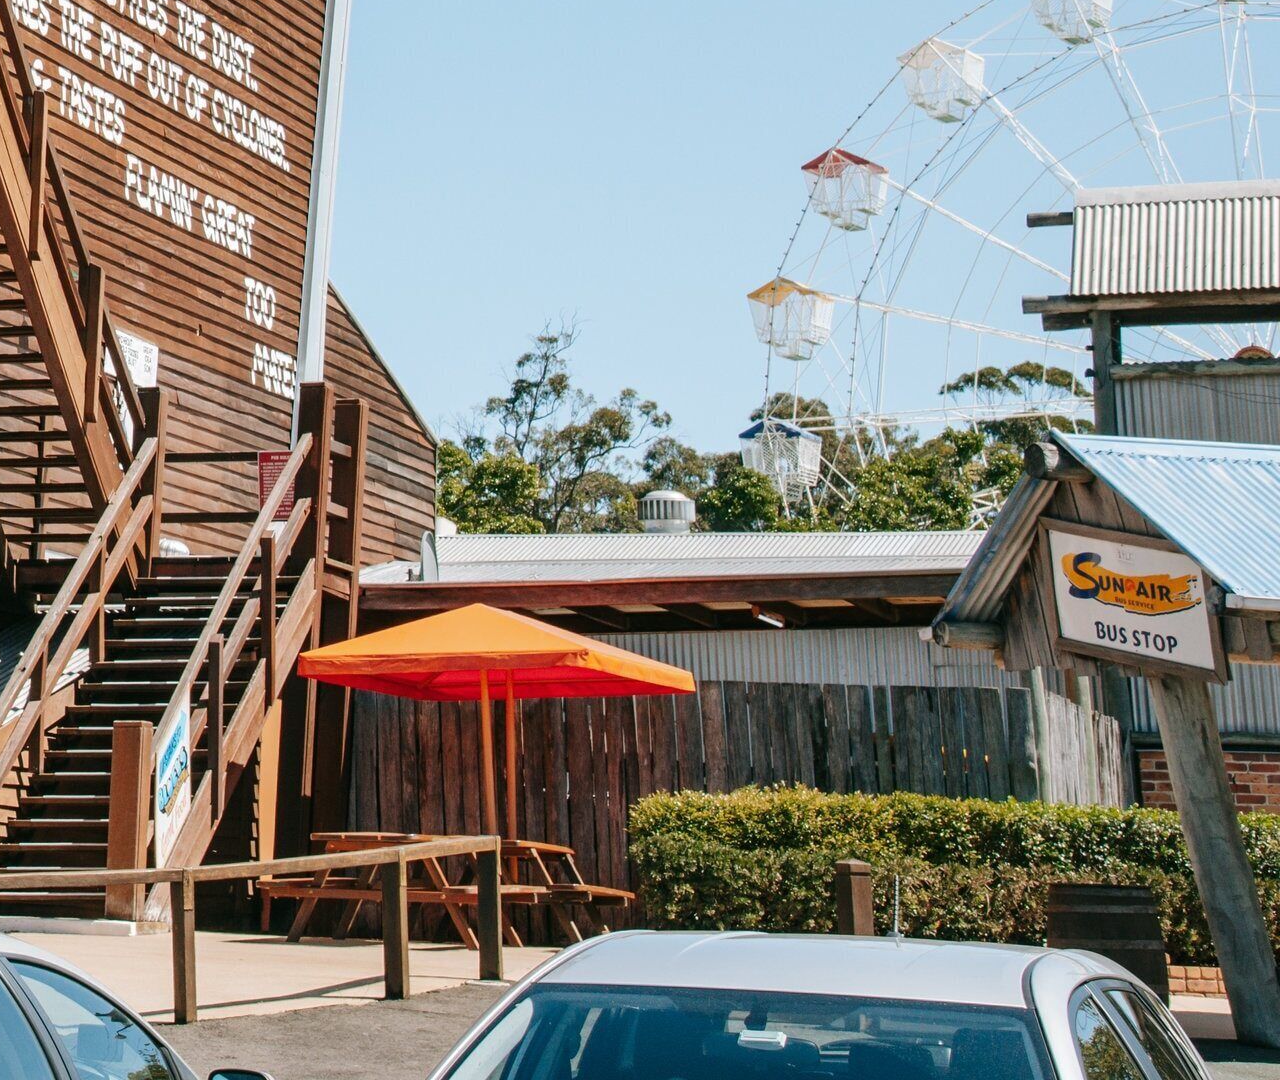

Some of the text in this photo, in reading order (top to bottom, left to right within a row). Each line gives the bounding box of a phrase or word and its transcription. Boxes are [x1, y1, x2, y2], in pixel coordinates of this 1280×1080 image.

[175, 0, 207, 59] THE
[99, 21, 143, 87] PUFF
[146, 47, 184, 109] OUT
[184, 74, 209, 119] OF
[58, 62, 126, 146] TASTES
[202, 194, 256, 260] GREAT
[243, 277, 276, 332] TOO
[1115, 596, 1155, 610] BUS SERVICE
[1136, 581, 1174, 604] AIR
[1095, 621, 1178, 654] BUS STOP
